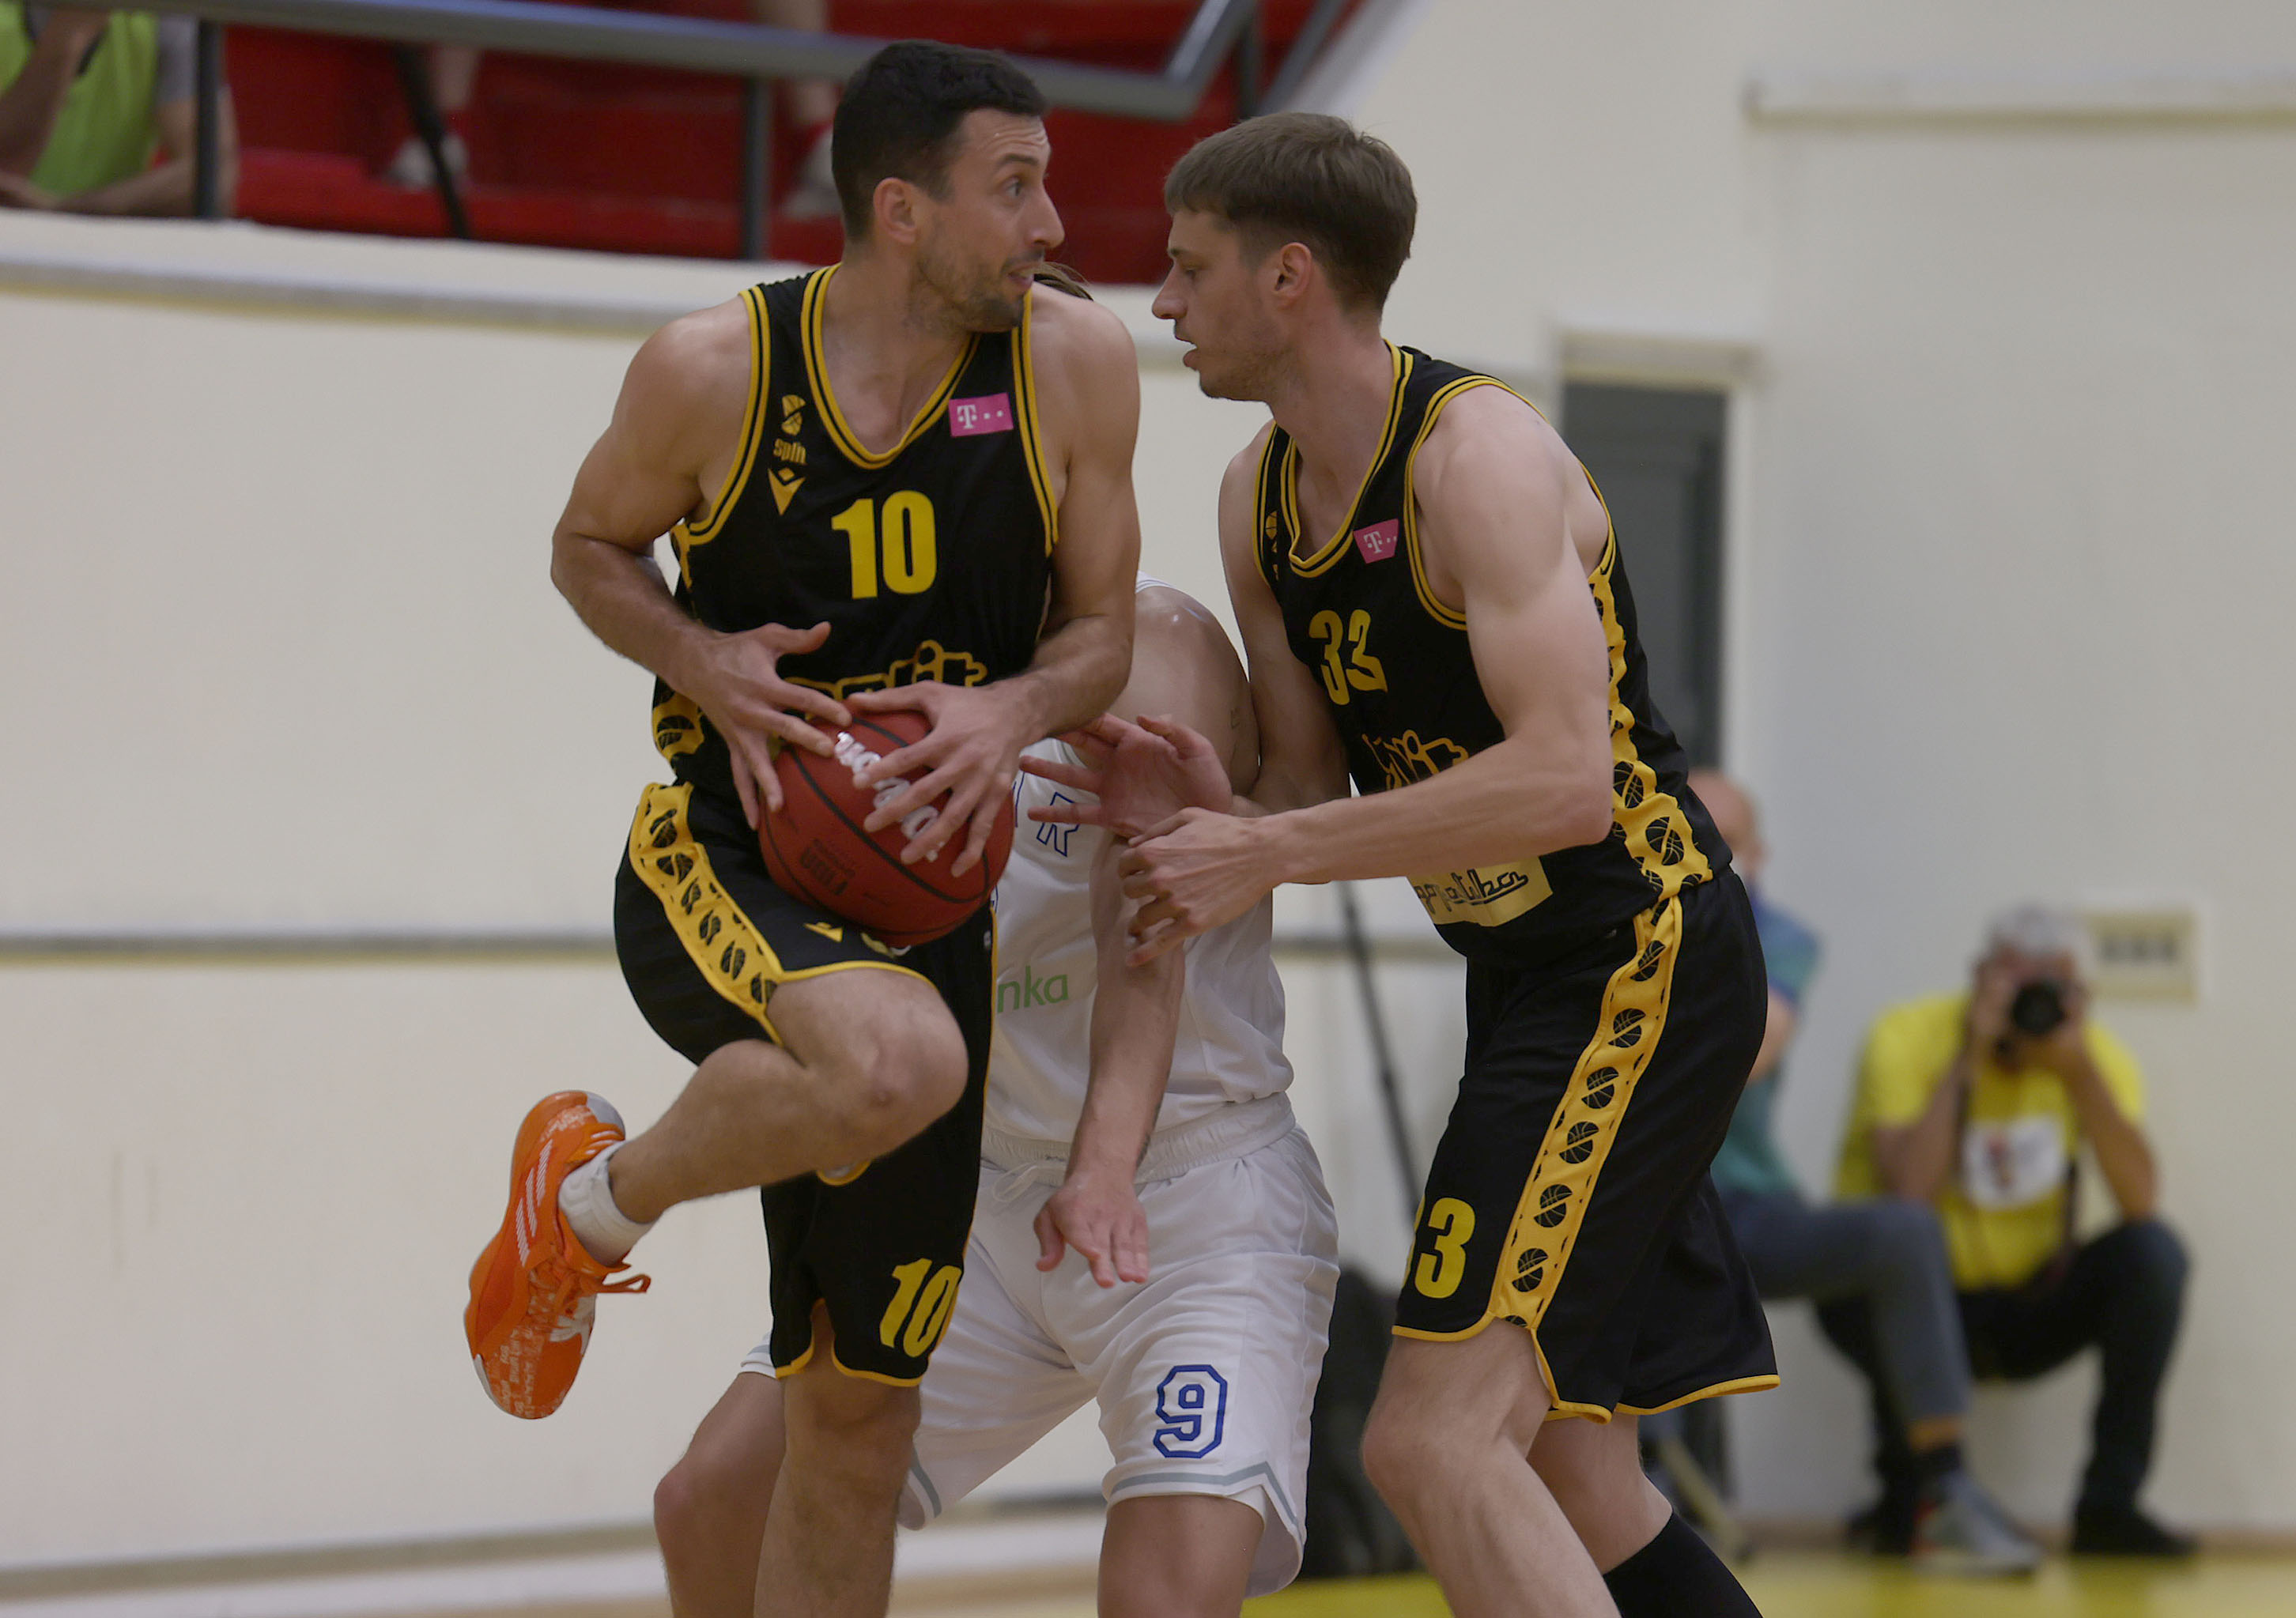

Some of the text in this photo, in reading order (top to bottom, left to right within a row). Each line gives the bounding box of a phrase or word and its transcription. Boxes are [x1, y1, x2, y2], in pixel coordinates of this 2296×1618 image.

[831, 489, 937, 599] 10
[1308, 609, 1388, 705] 33
[879, 1258, 962, 1358] 10
[1153, 1364, 1228, 1458] 9
